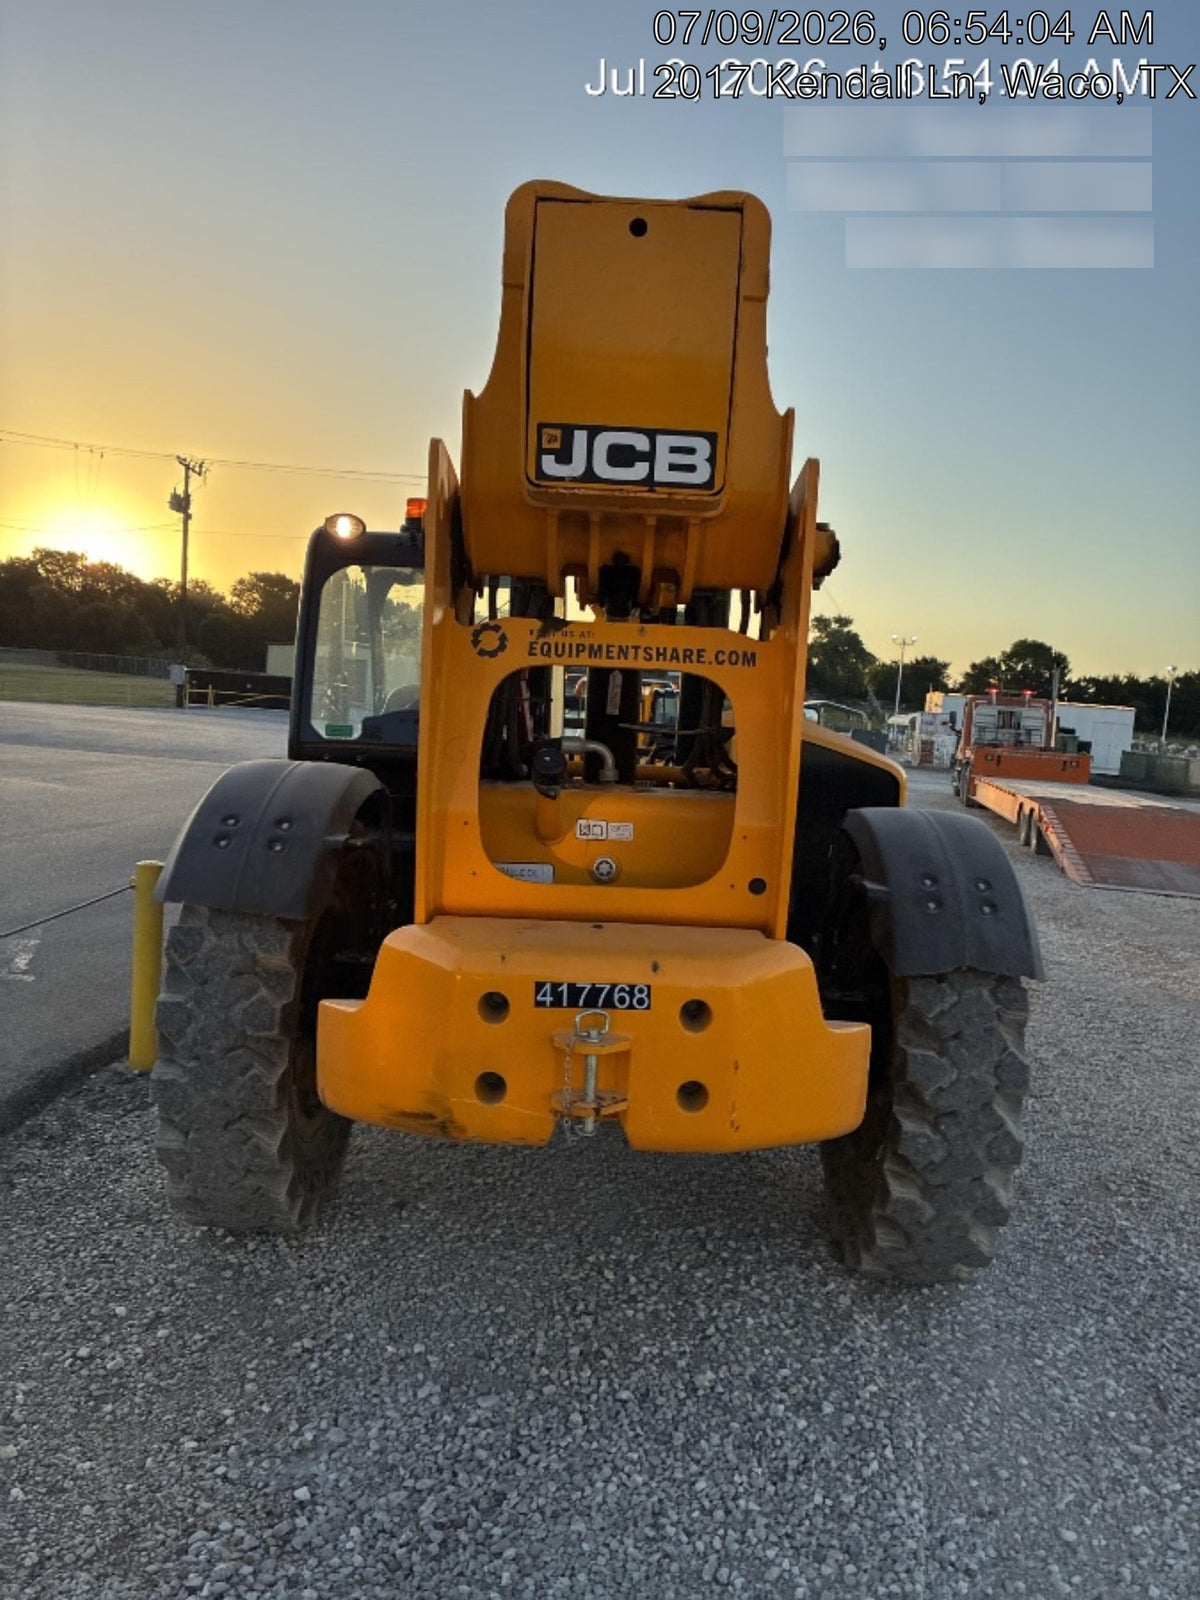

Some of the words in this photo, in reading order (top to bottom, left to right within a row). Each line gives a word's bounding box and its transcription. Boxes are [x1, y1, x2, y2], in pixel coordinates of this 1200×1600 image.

[541, 430, 712, 484] JCB
[528, 641, 757, 668] EQUIPMENTSHARE.COM
[536, 982, 650, 1009] 417768
